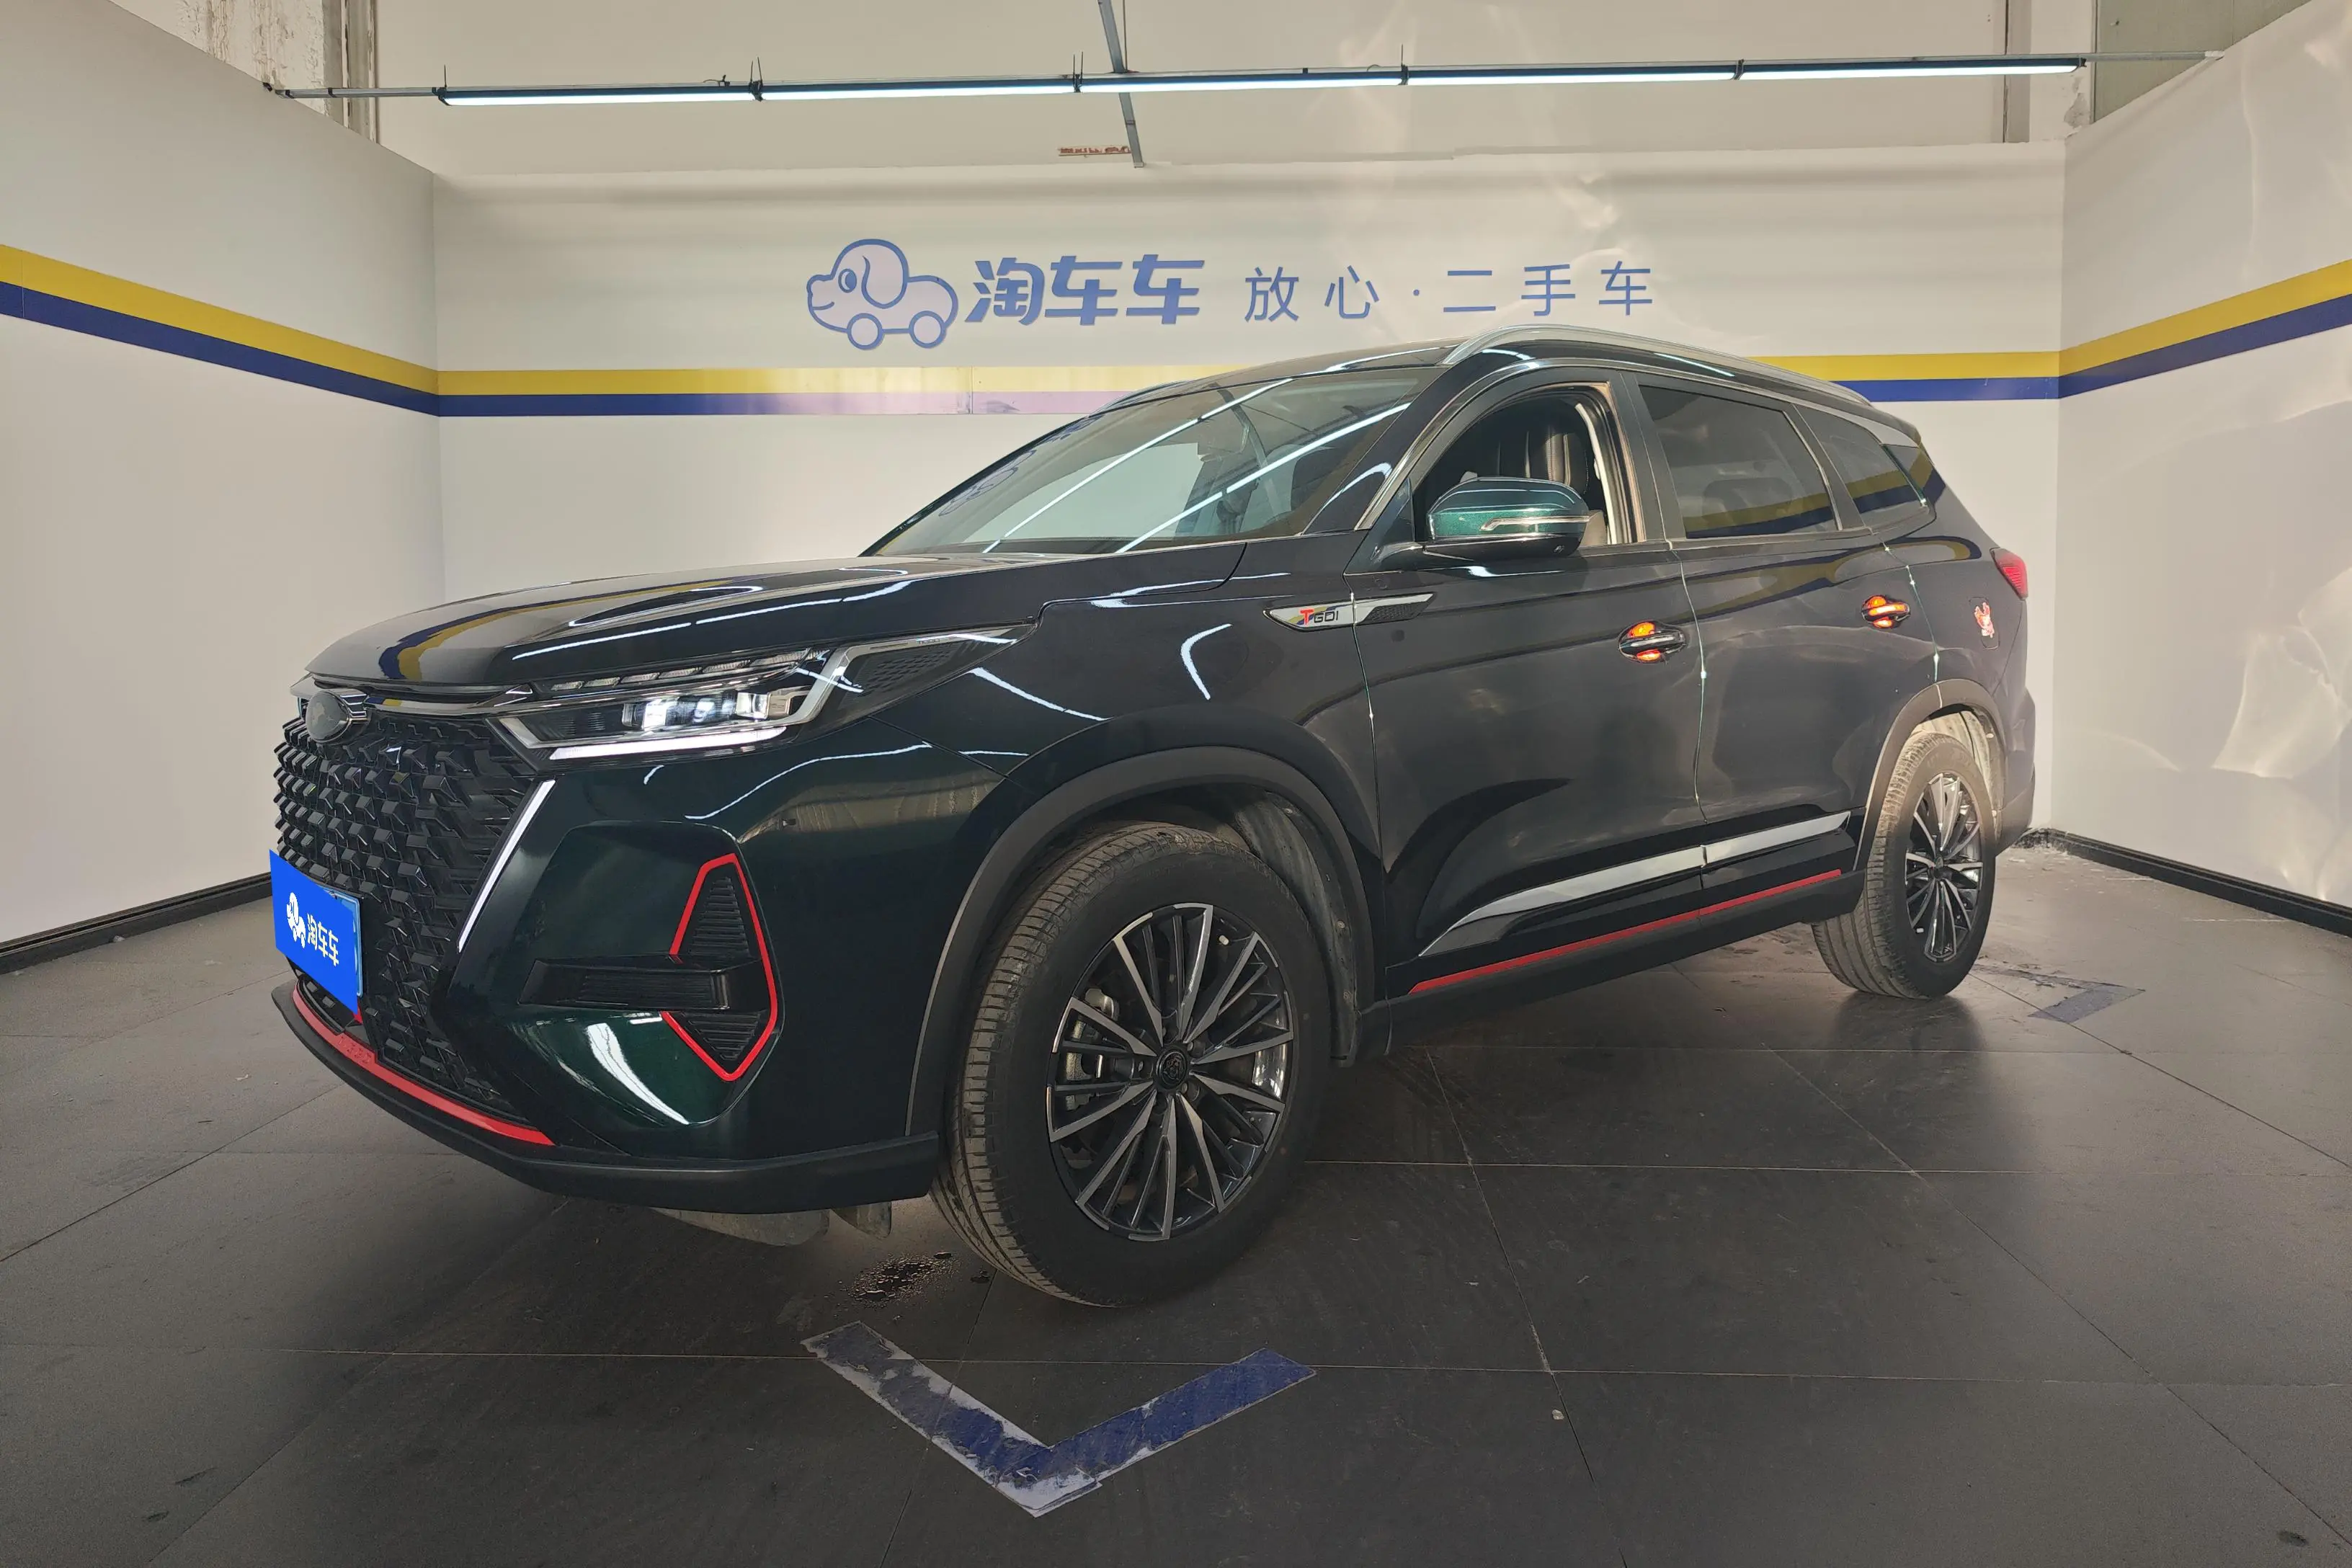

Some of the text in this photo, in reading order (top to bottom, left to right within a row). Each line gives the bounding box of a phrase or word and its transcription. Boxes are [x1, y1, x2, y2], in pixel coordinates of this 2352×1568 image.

[964, 254, 1205, 326] 淘车车
[1298, 607, 1339, 626] TGDI
